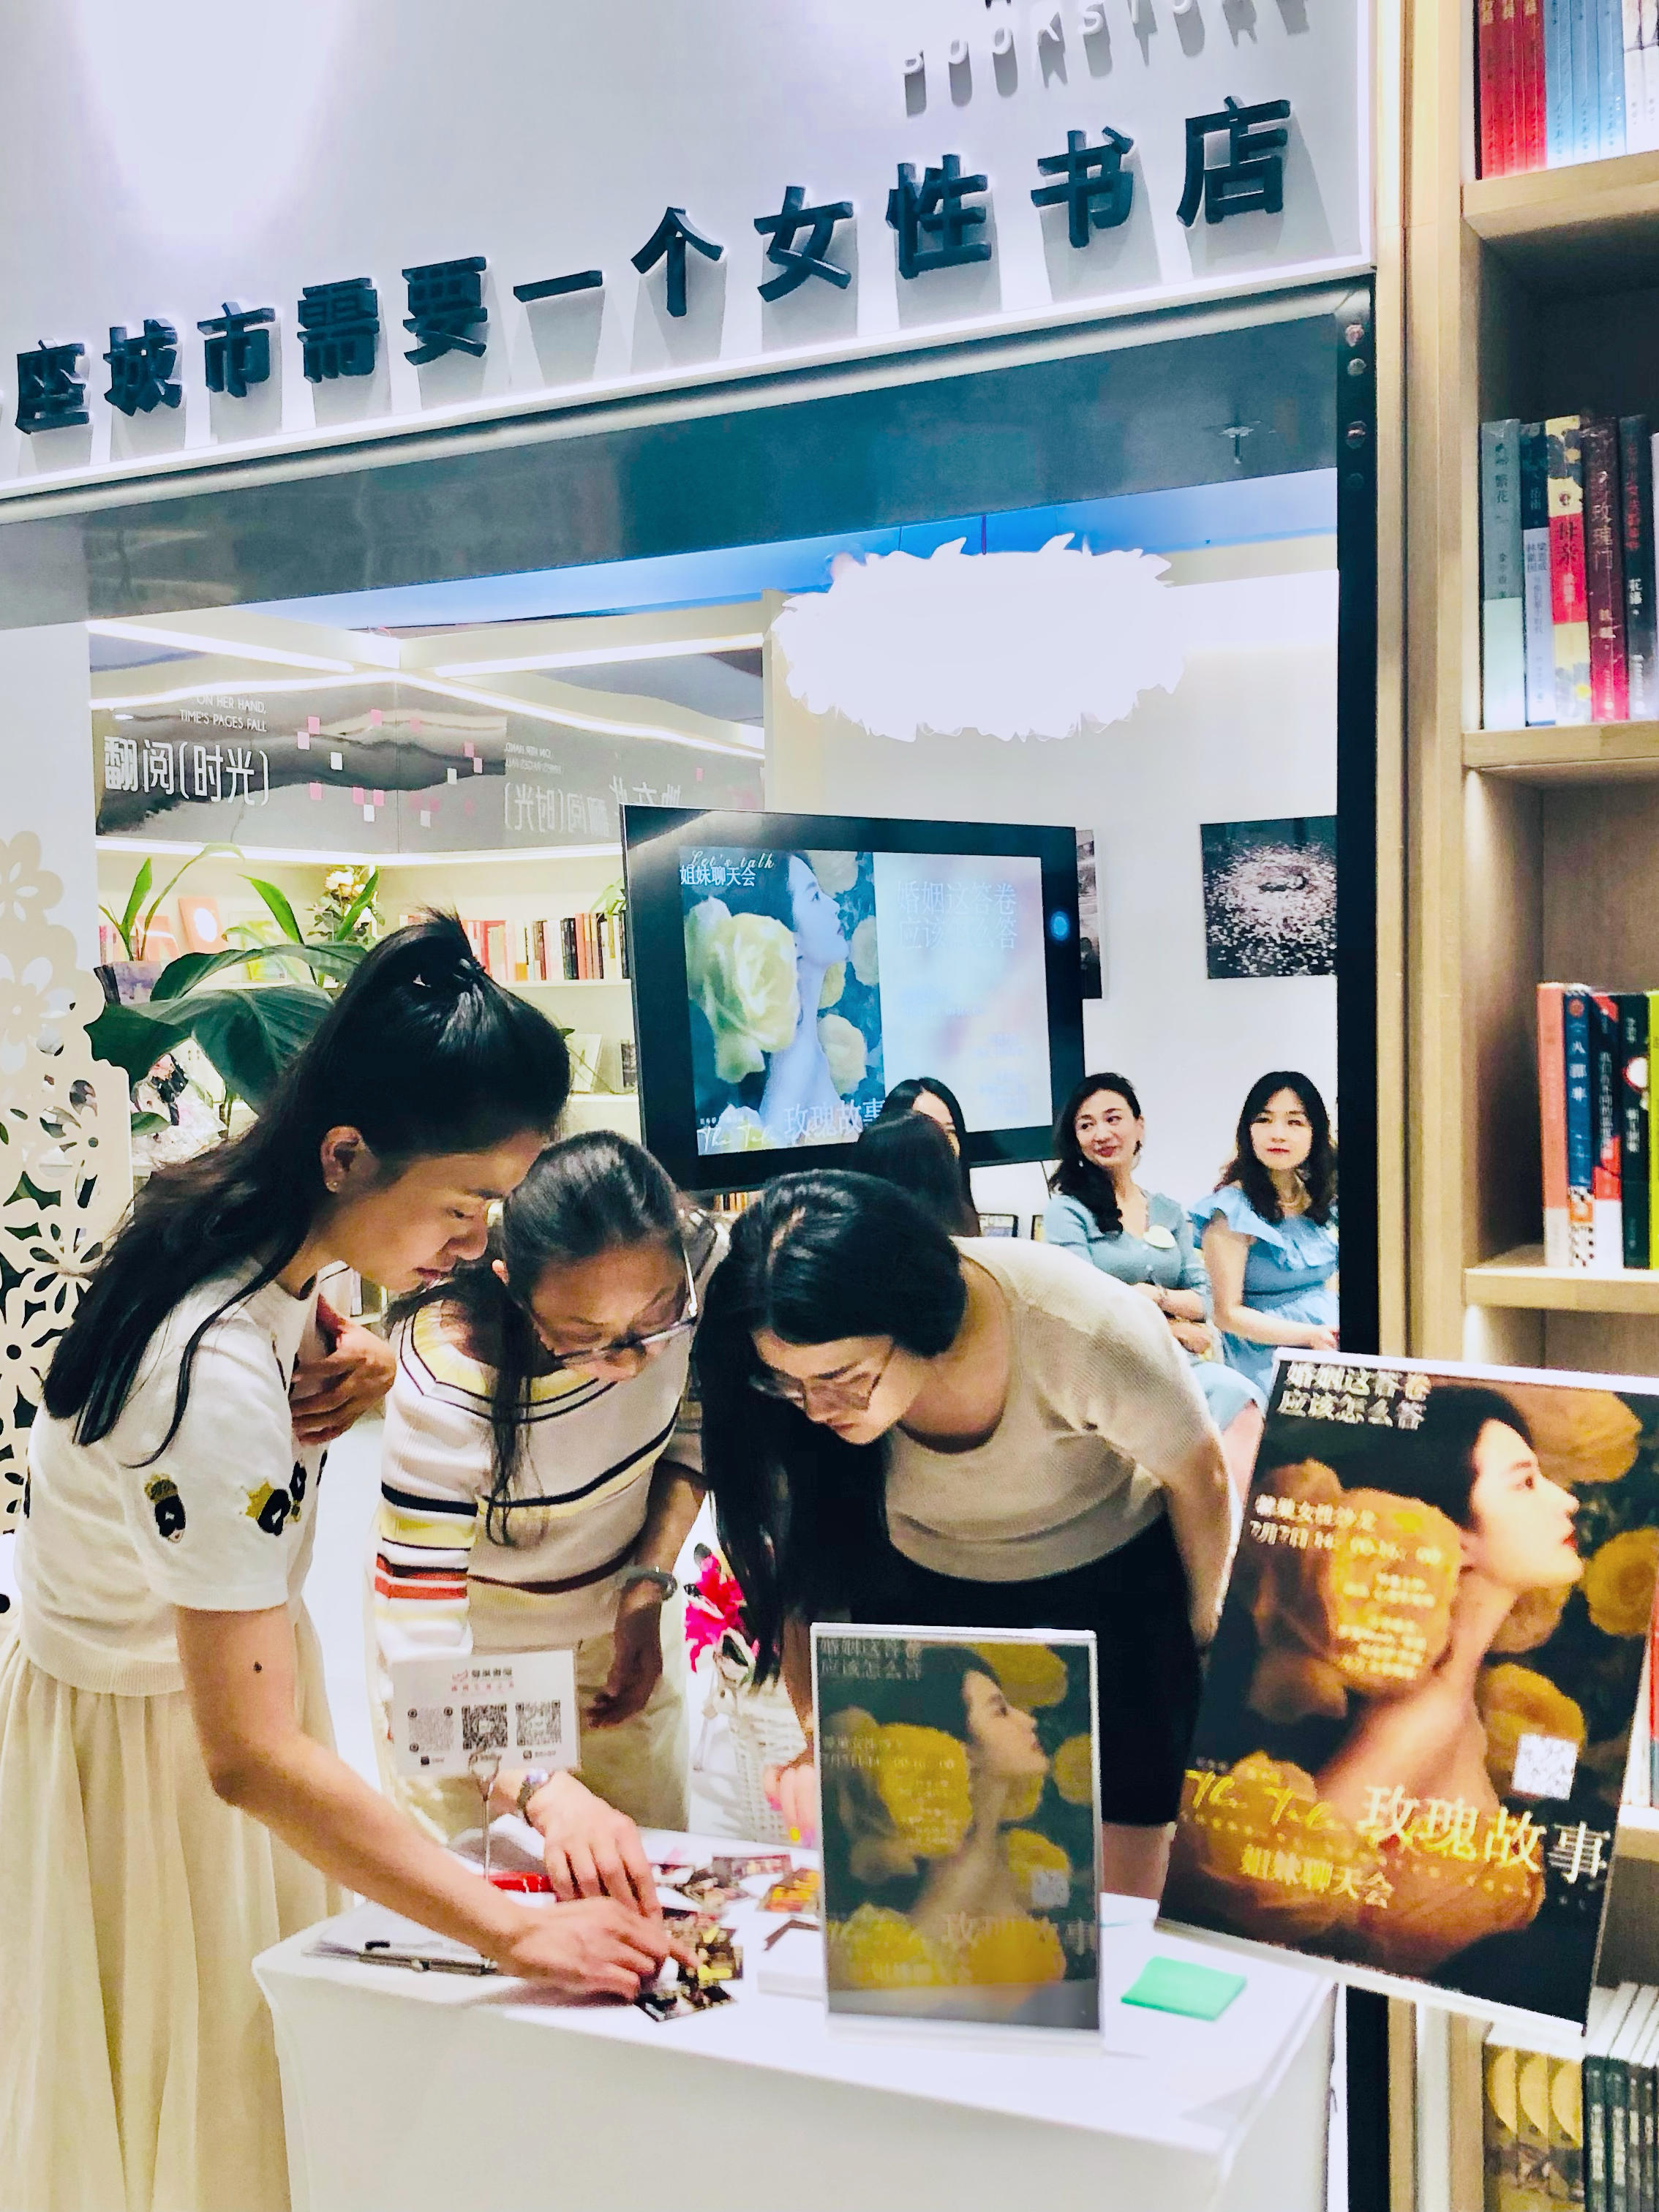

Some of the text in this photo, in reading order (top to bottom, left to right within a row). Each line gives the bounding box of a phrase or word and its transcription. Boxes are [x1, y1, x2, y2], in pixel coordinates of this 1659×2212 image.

[217, 697, 235, 709] HER
[238, 699, 267, 715] HAND,
[179, 709, 267, 732] TIME'S PAGES FALL
[691, 850, 775, 870] Let's talk
[679, 864, 757, 887] 姐妹聊天会
[896, 880, 1017, 916] 婚姻这答卷
[1355, 1784, 1611, 1885] 玫瑰故事
